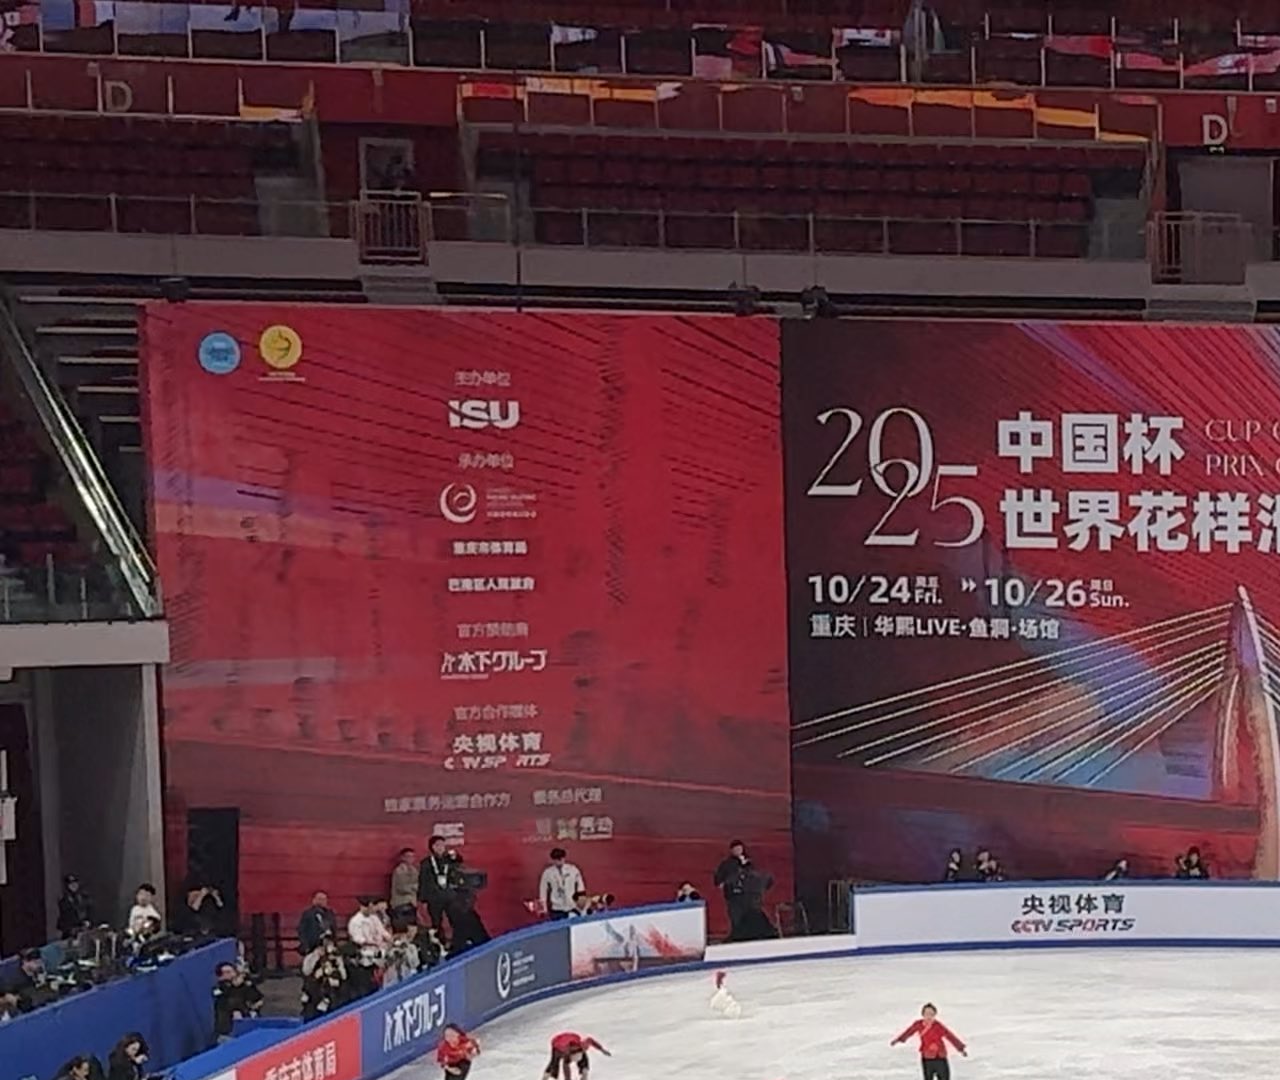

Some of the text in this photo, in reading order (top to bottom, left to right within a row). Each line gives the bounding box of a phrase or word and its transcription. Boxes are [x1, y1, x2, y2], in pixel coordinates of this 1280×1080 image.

[105, 81, 132, 112] D
[1202, 115, 1228, 145] D
[448, 399, 520, 430] ISU
[996, 411, 1186, 476] 中国杯
[1204, 419, 1262, 443] CUP
[1204, 454, 1264, 479] PRIX
[808, 574, 911, 605] 10/24
[914, 588, 943, 604] Fri.
[984, 577, 1087, 608] 10/26
[1089, 592, 1130, 608] Sun.
[809, 613, 857, 638] 重庆
[453, 732, 543, 753] 央视体育
[1022, 893, 1125, 915] 央视体育
[1011, 917, 1137, 934] CCTV SPORTS
